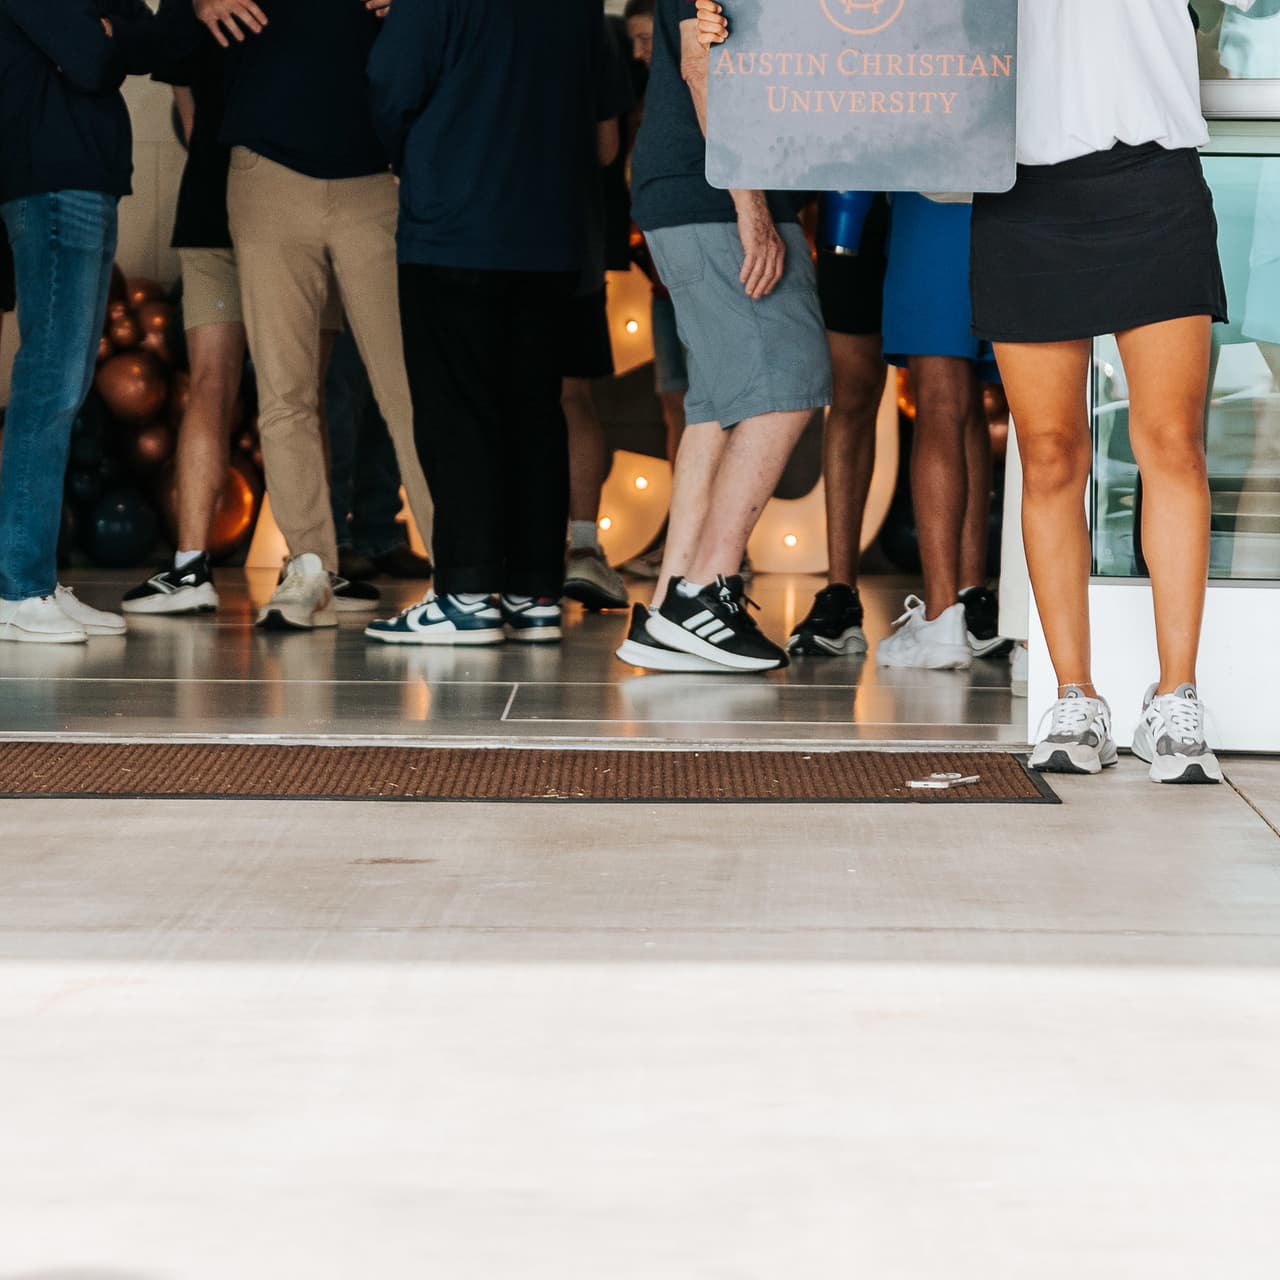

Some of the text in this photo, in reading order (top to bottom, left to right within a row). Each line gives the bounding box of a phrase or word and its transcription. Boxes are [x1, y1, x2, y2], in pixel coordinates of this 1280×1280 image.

[714, 48, 1013, 77] AUSTIN CHRISTIAN
[767, 85, 959, 114] UNIVERSITY
